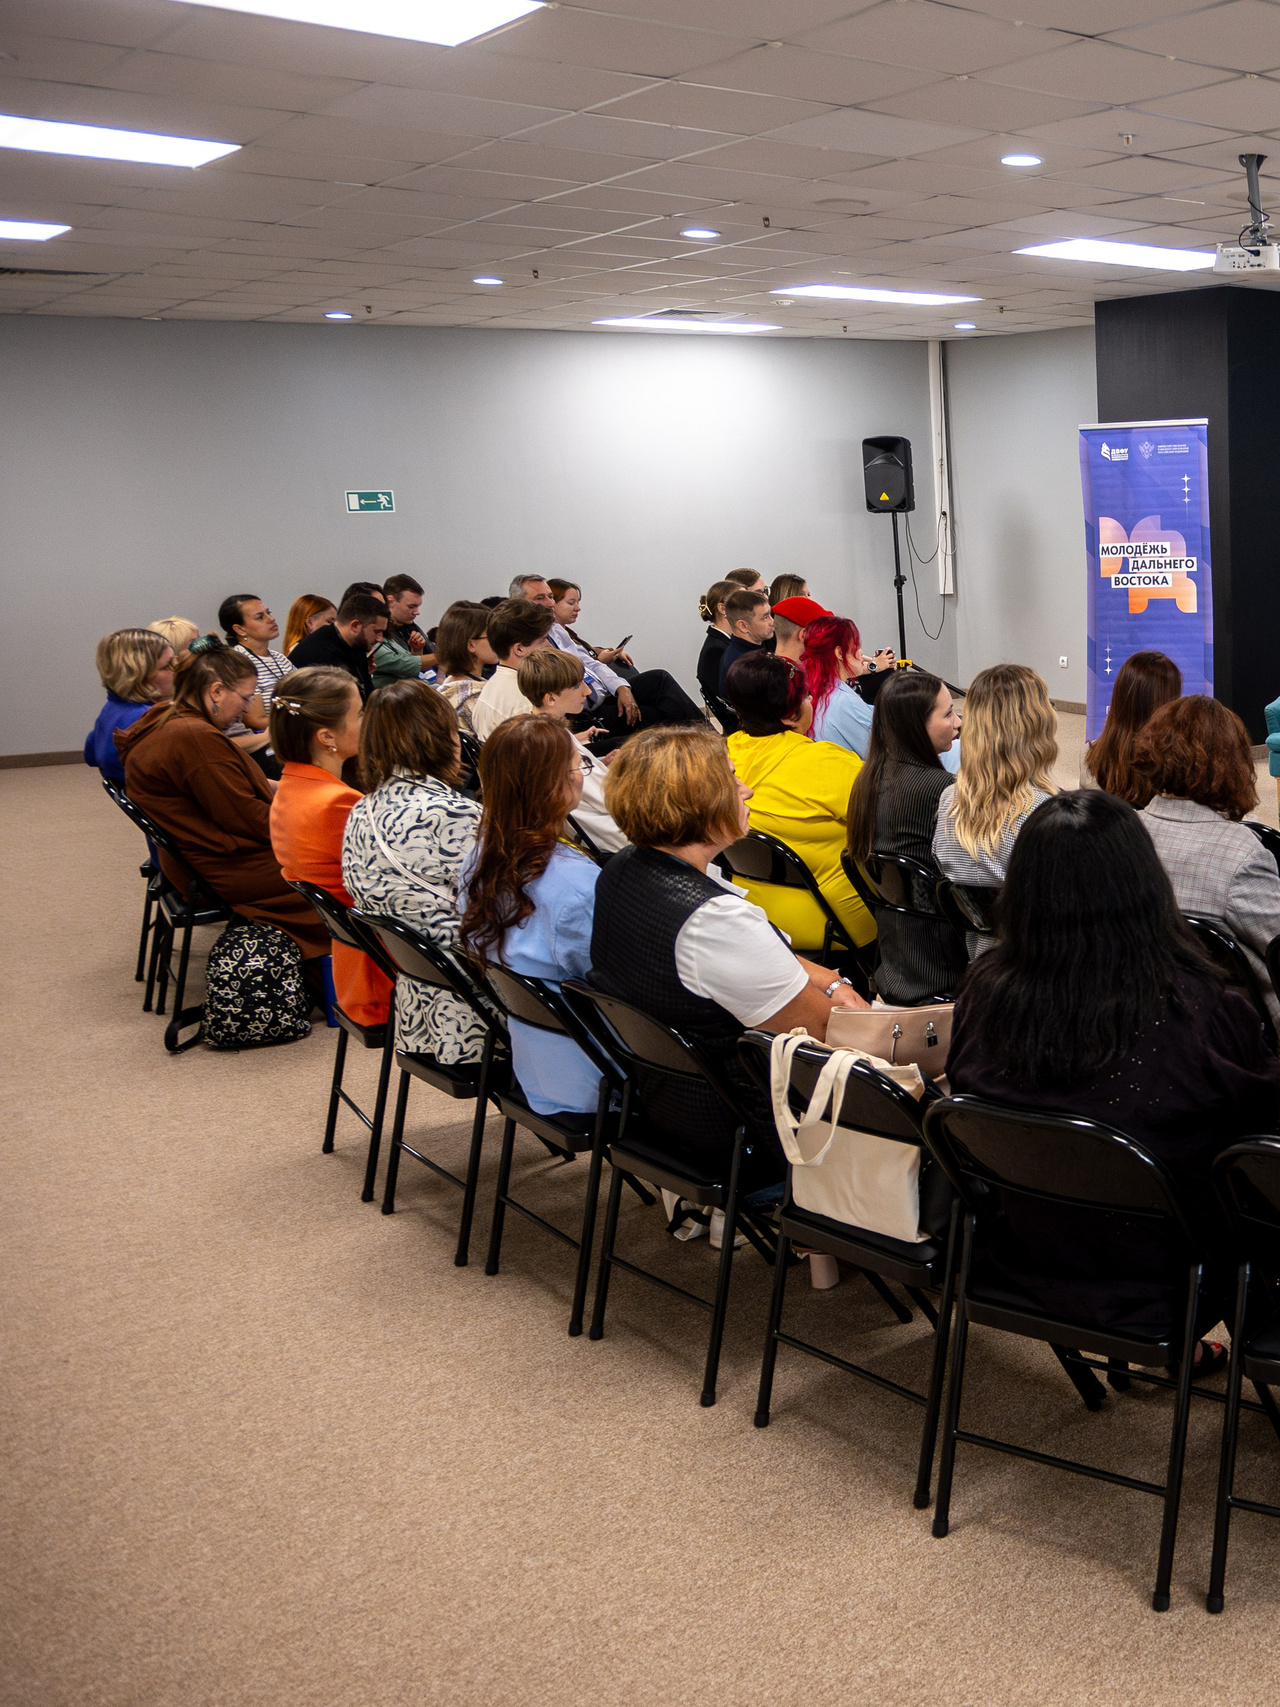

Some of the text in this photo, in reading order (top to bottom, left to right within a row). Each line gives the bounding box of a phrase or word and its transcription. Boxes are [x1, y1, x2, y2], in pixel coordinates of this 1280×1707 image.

[1101, 542, 1168, 556] МОЛОДЁЖЬ
[1131, 559, 1195, 571] ДАЛЬНЕГО
[1114, 575, 1169, 586] ВОСТОКА
